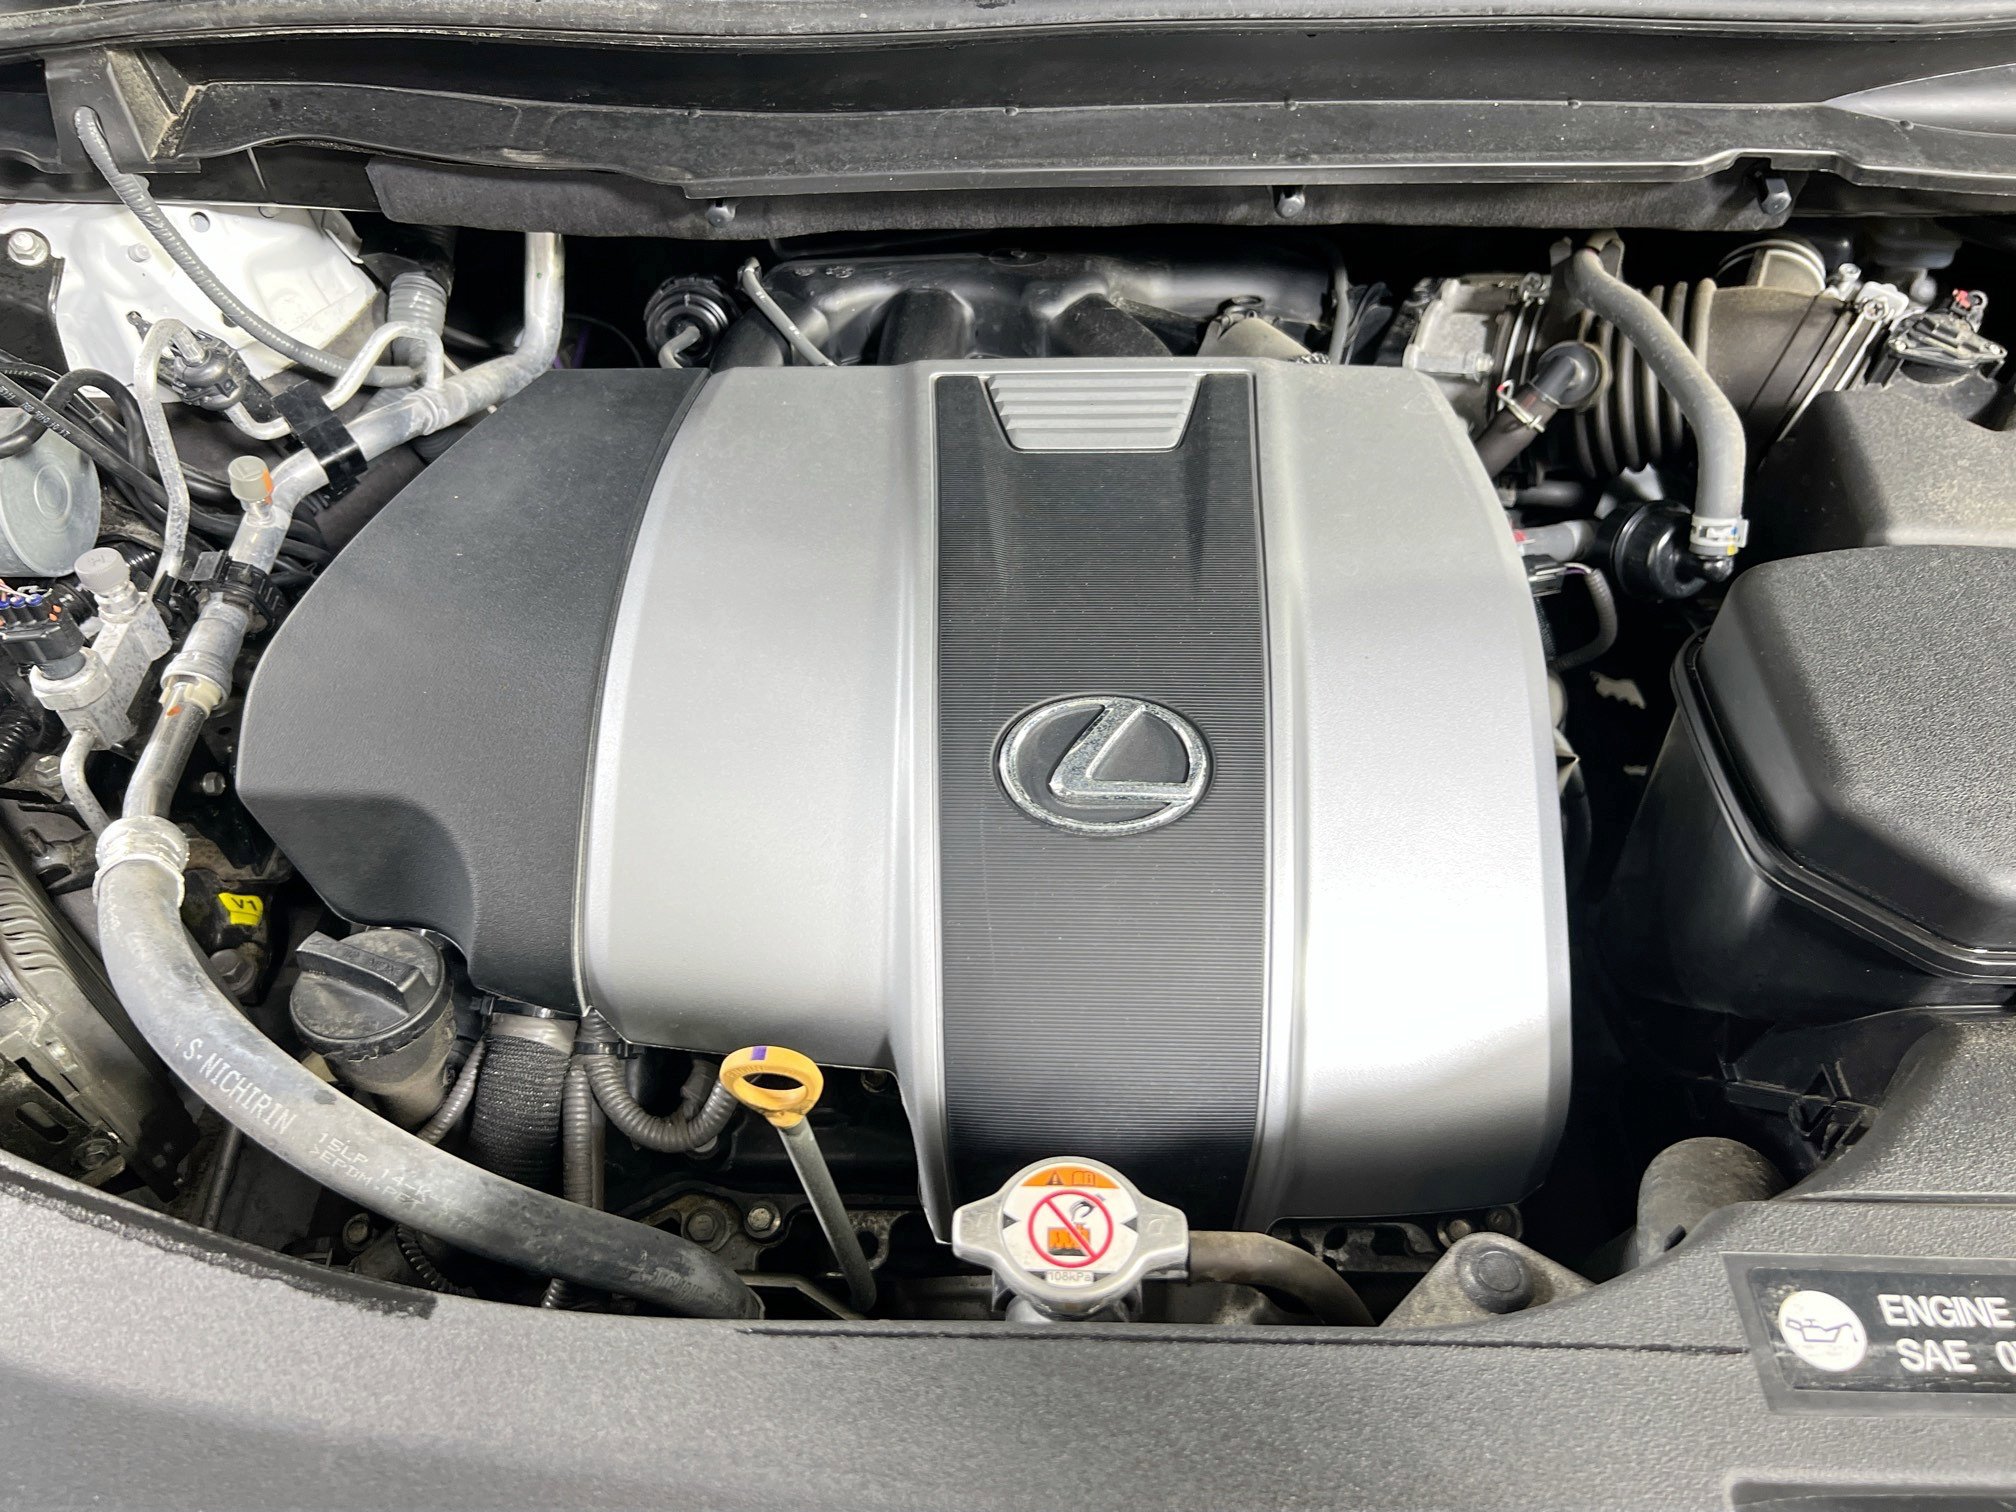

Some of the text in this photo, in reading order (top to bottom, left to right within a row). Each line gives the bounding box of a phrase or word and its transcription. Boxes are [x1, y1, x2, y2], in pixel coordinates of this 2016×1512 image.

[230, 896, 257, 911] V1
[1047, 1270, 1092, 1282] 108kPa
[1877, 1293, 2016, 1329] ENGINE
[1896, 1338, 1977, 1373] SAE
